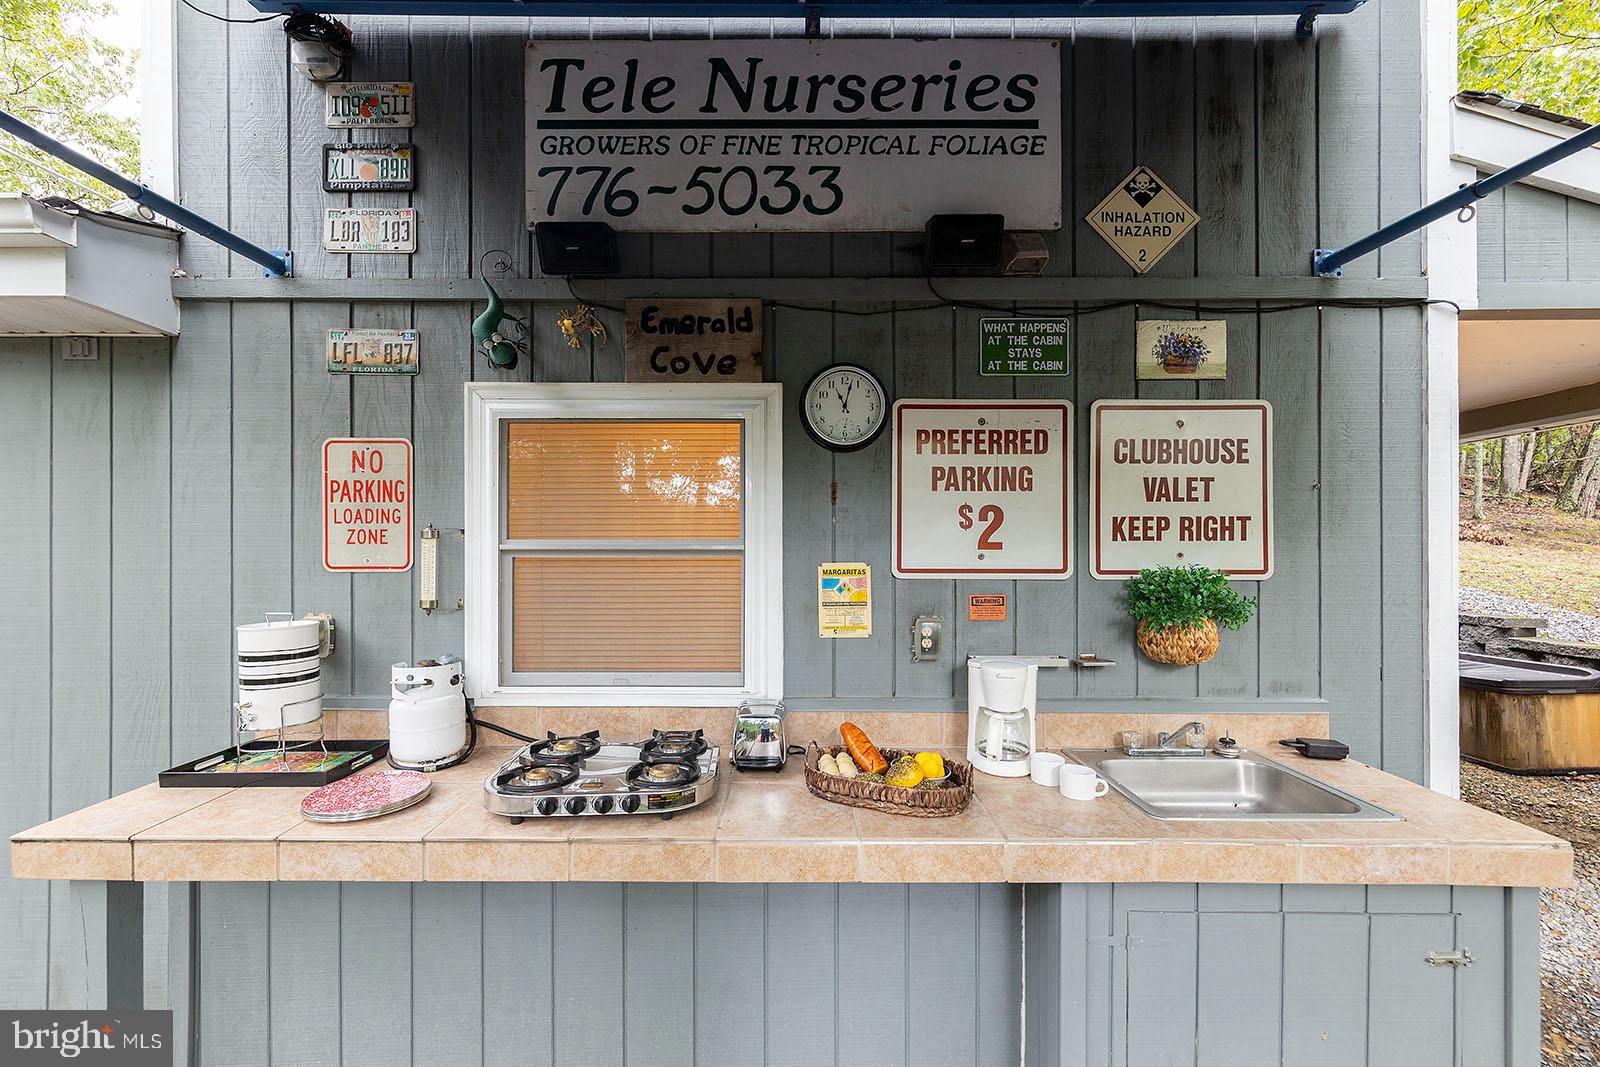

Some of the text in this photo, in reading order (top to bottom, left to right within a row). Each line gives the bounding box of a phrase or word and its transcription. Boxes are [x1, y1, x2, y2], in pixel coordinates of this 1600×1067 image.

[539, 57, 1039, 114] Tele Nurseries
[346, 117, 368, 125] PALM
[539, 135, 1048, 156] GROWERS OF FINE TROPICAL FOLIAGE
[349, 209, 393, 217] FLORIDA
[1100, 211, 1185, 223] INHALATION
[381, 220, 410, 243] 183
[1114, 225, 1172, 237] HAZARD
[352, 243, 389, 251] PANTHER
[1138, 249, 1147, 262] 2
[640, 305, 754, 335] Emerald
[983, 323, 1067, 333] WHAT HAPPENS
[987, 336, 1063, 345] AT THE CABIN
[332, 342, 413, 365] LFL 837
[1008, 348, 1042, 358] STAYS
[650, 345, 738, 375] Cove
[987, 361, 1063, 370] AT THE CABIN
[828, 380, 835, 389] 11
[840, 376, 849, 385] 12
[856, 380, 860, 389] 1
[819, 390, 829, 399] 10
[865, 388, 871, 398] 2
[815, 402, 822, 412] 9
[868, 402, 874, 411] 3
[828, 425, 835, 434] 7
[842, 429, 848, 438] 6
[915, 429, 1049, 455] PREFERRED
[1113, 438, 1250, 465] CLUBHOUSE
[351, 449, 384, 474] NO
[931, 466, 1034, 492] PARKING
[329, 479, 406, 503] PARKING
[1143, 476, 1215, 502] VALET
[333, 508, 402, 524] LOADING
[957, 502, 1005, 550] $2
[1111, 516, 1252, 542] KEEP RIGHT
[346, 529, 389, 545] ZONE
[822, 568, 867, 576] MARGARITAS
